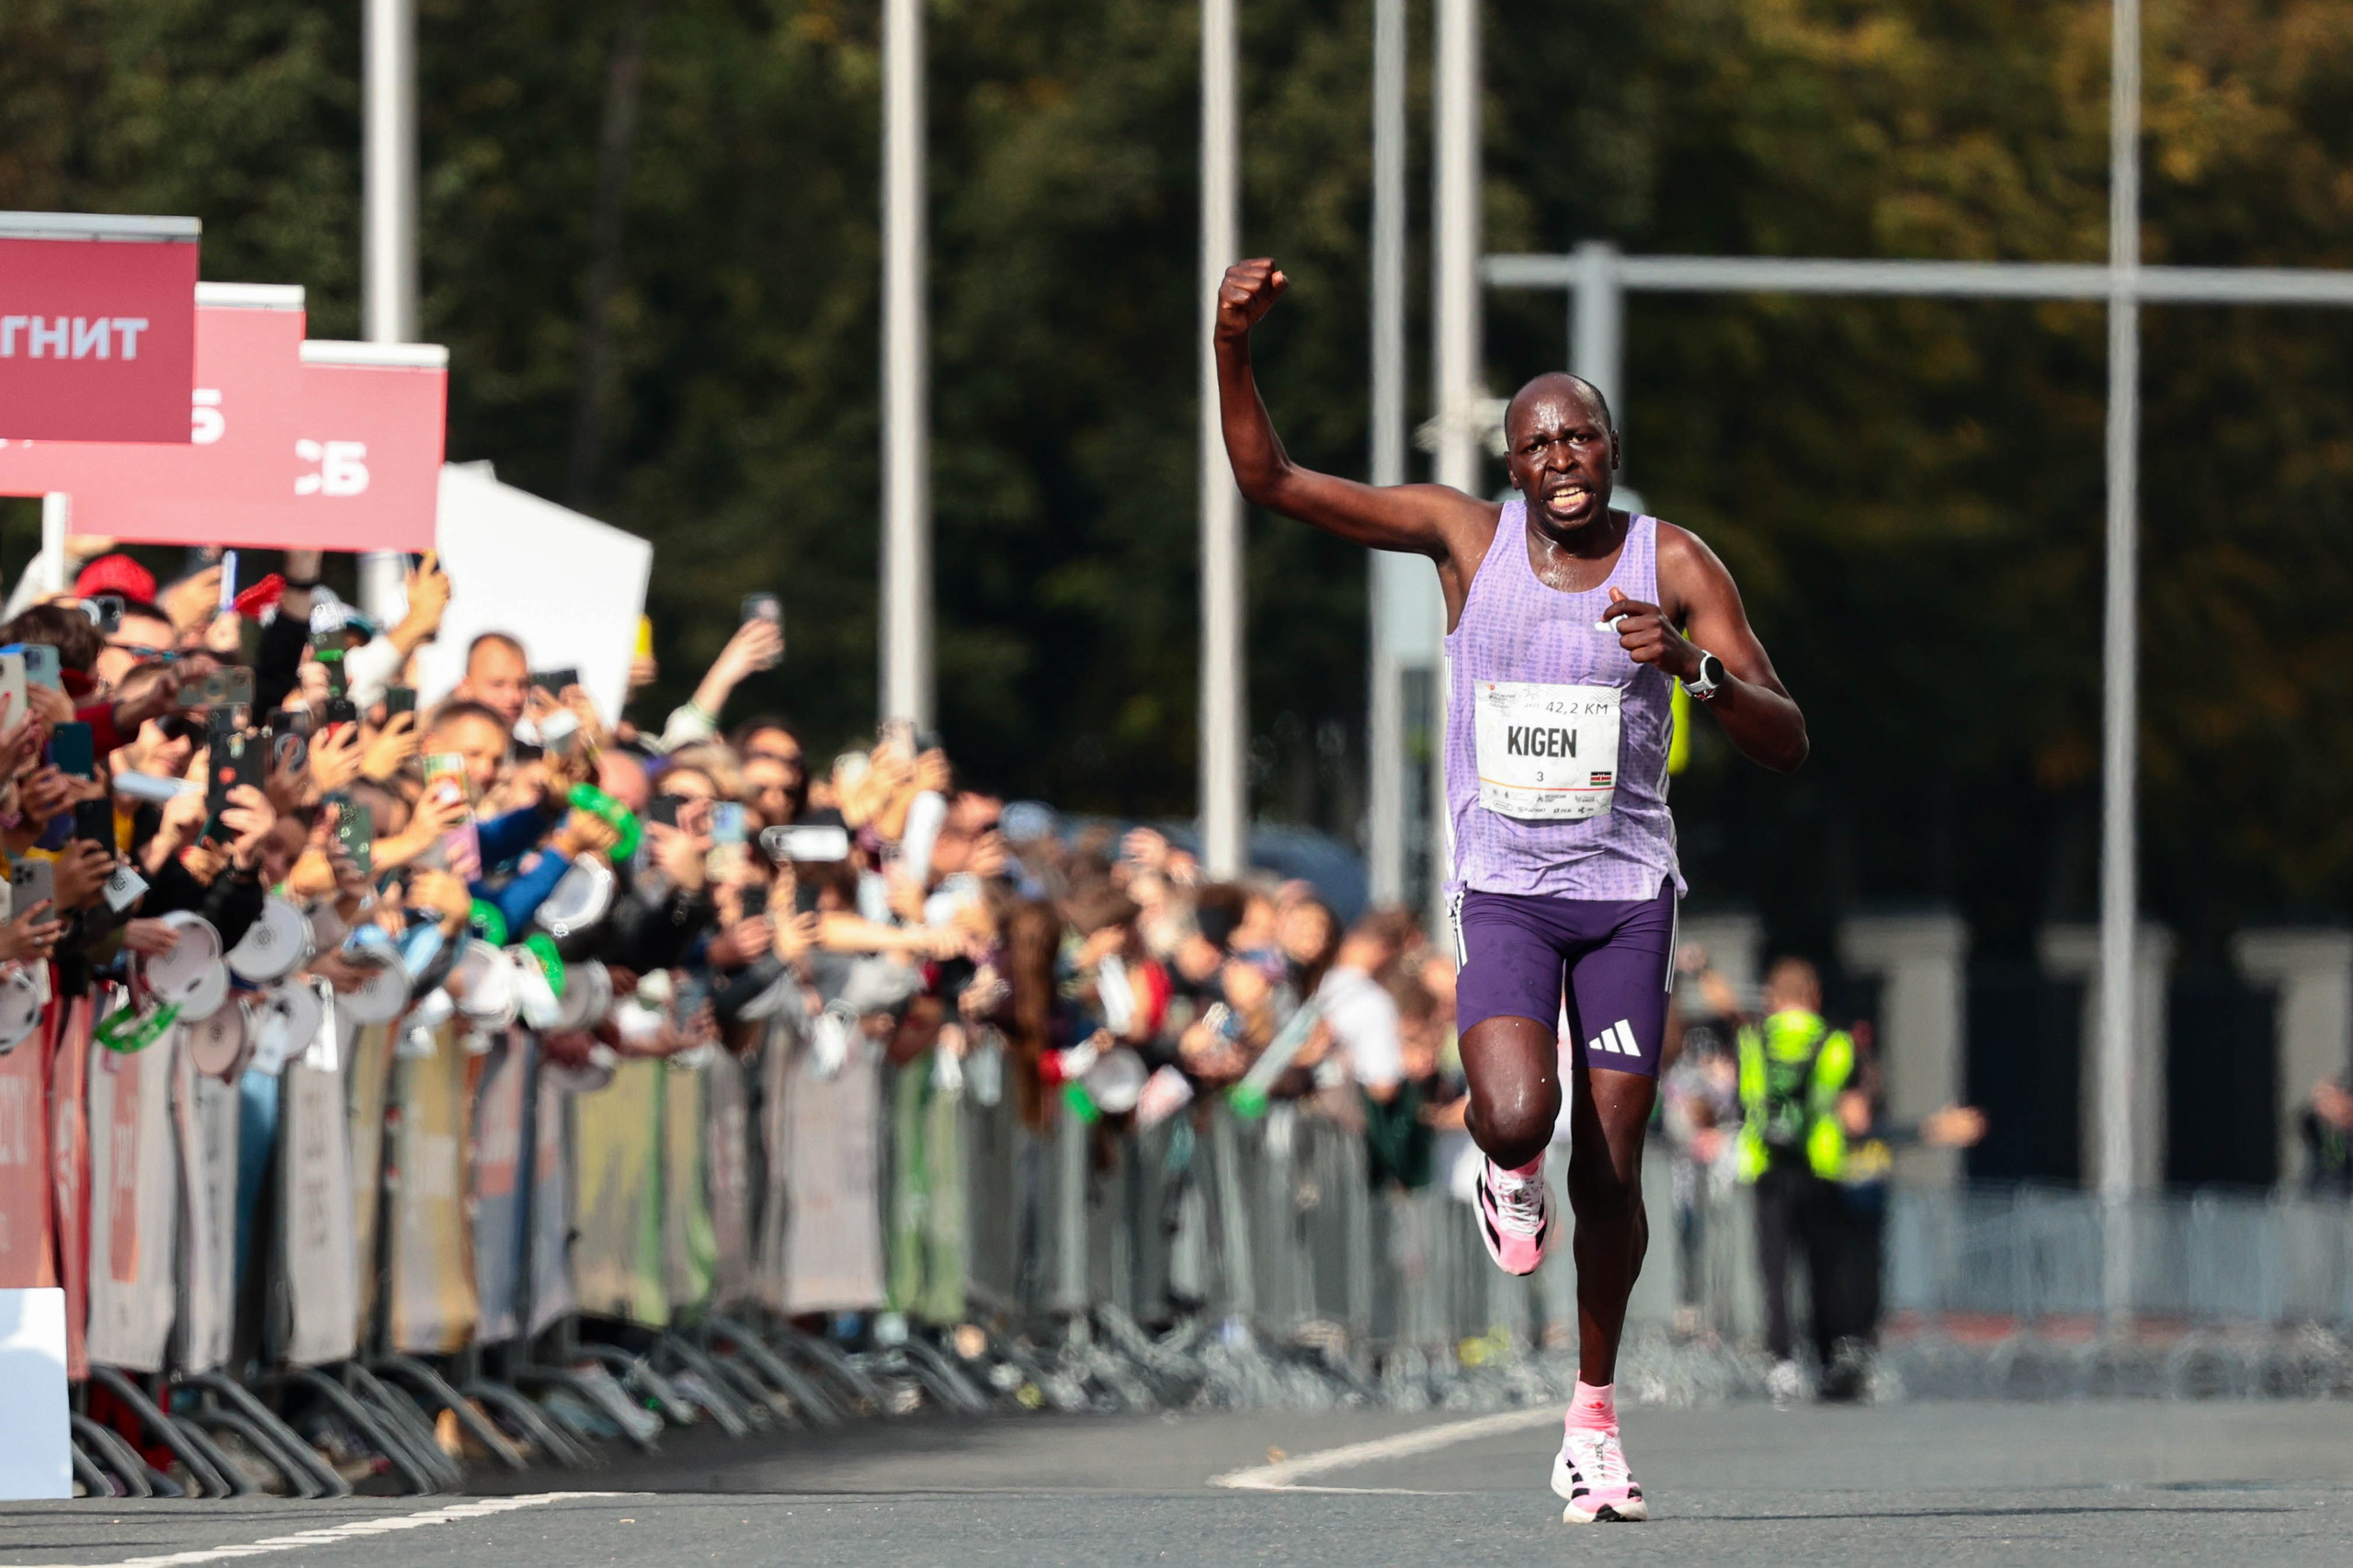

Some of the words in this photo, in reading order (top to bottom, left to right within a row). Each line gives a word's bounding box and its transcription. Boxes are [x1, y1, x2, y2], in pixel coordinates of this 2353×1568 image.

[1545, 700, 1579, 715] 42,2
[1585, 702, 1608, 715] KM
[1507, 725, 1577, 758] KIGEN
[1536, 770, 1544, 782] 3
